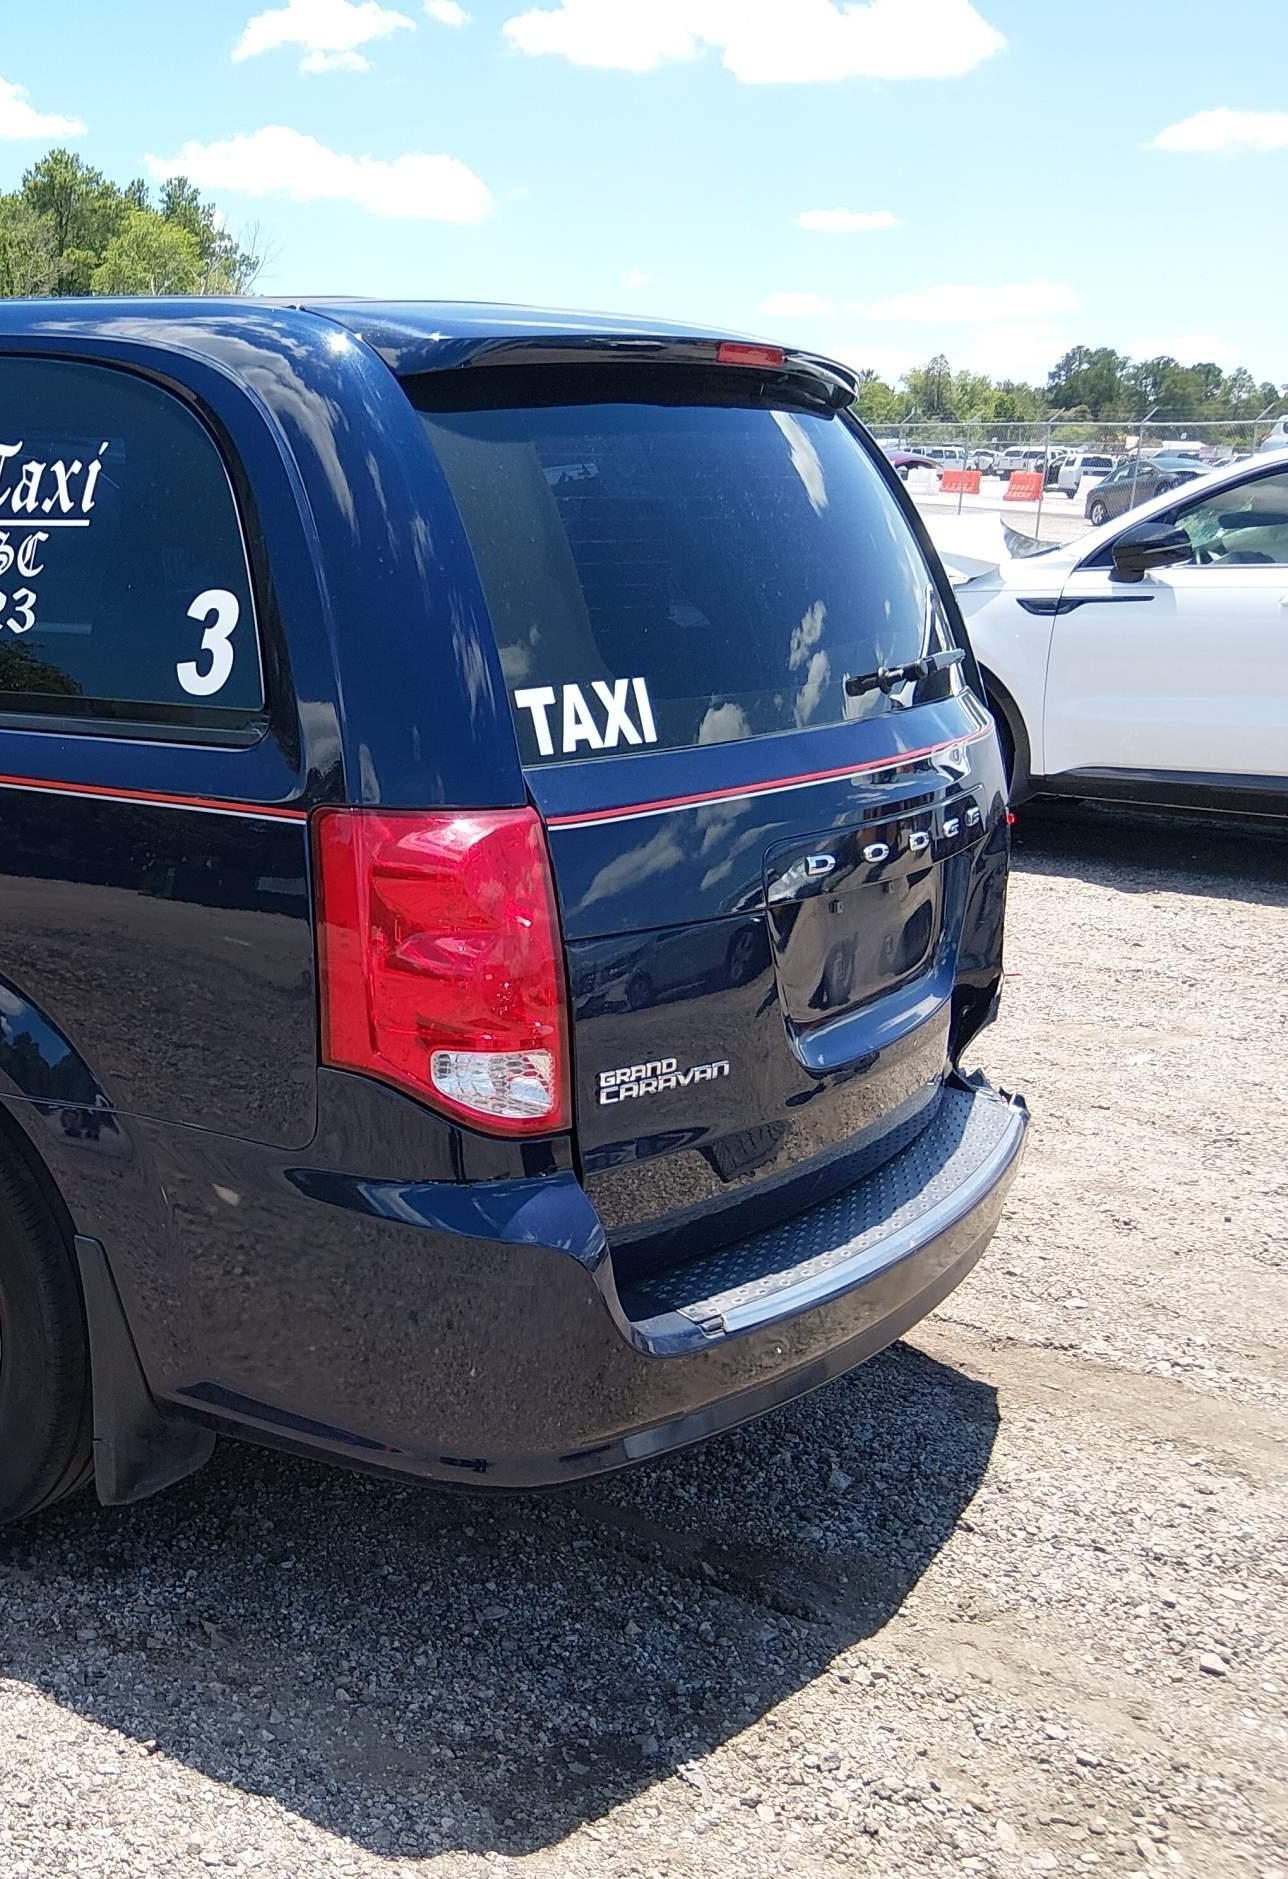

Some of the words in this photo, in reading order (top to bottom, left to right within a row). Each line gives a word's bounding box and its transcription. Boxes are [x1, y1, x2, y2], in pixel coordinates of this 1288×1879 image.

[175, 588, 240, 696] 3
[514, 676, 658, 757] TAXI
[805, 806, 981, 876] DODGE
[599, 1057, 678, 1088] GRAND
[599, 1059, 731, 1106] CARAVAN
